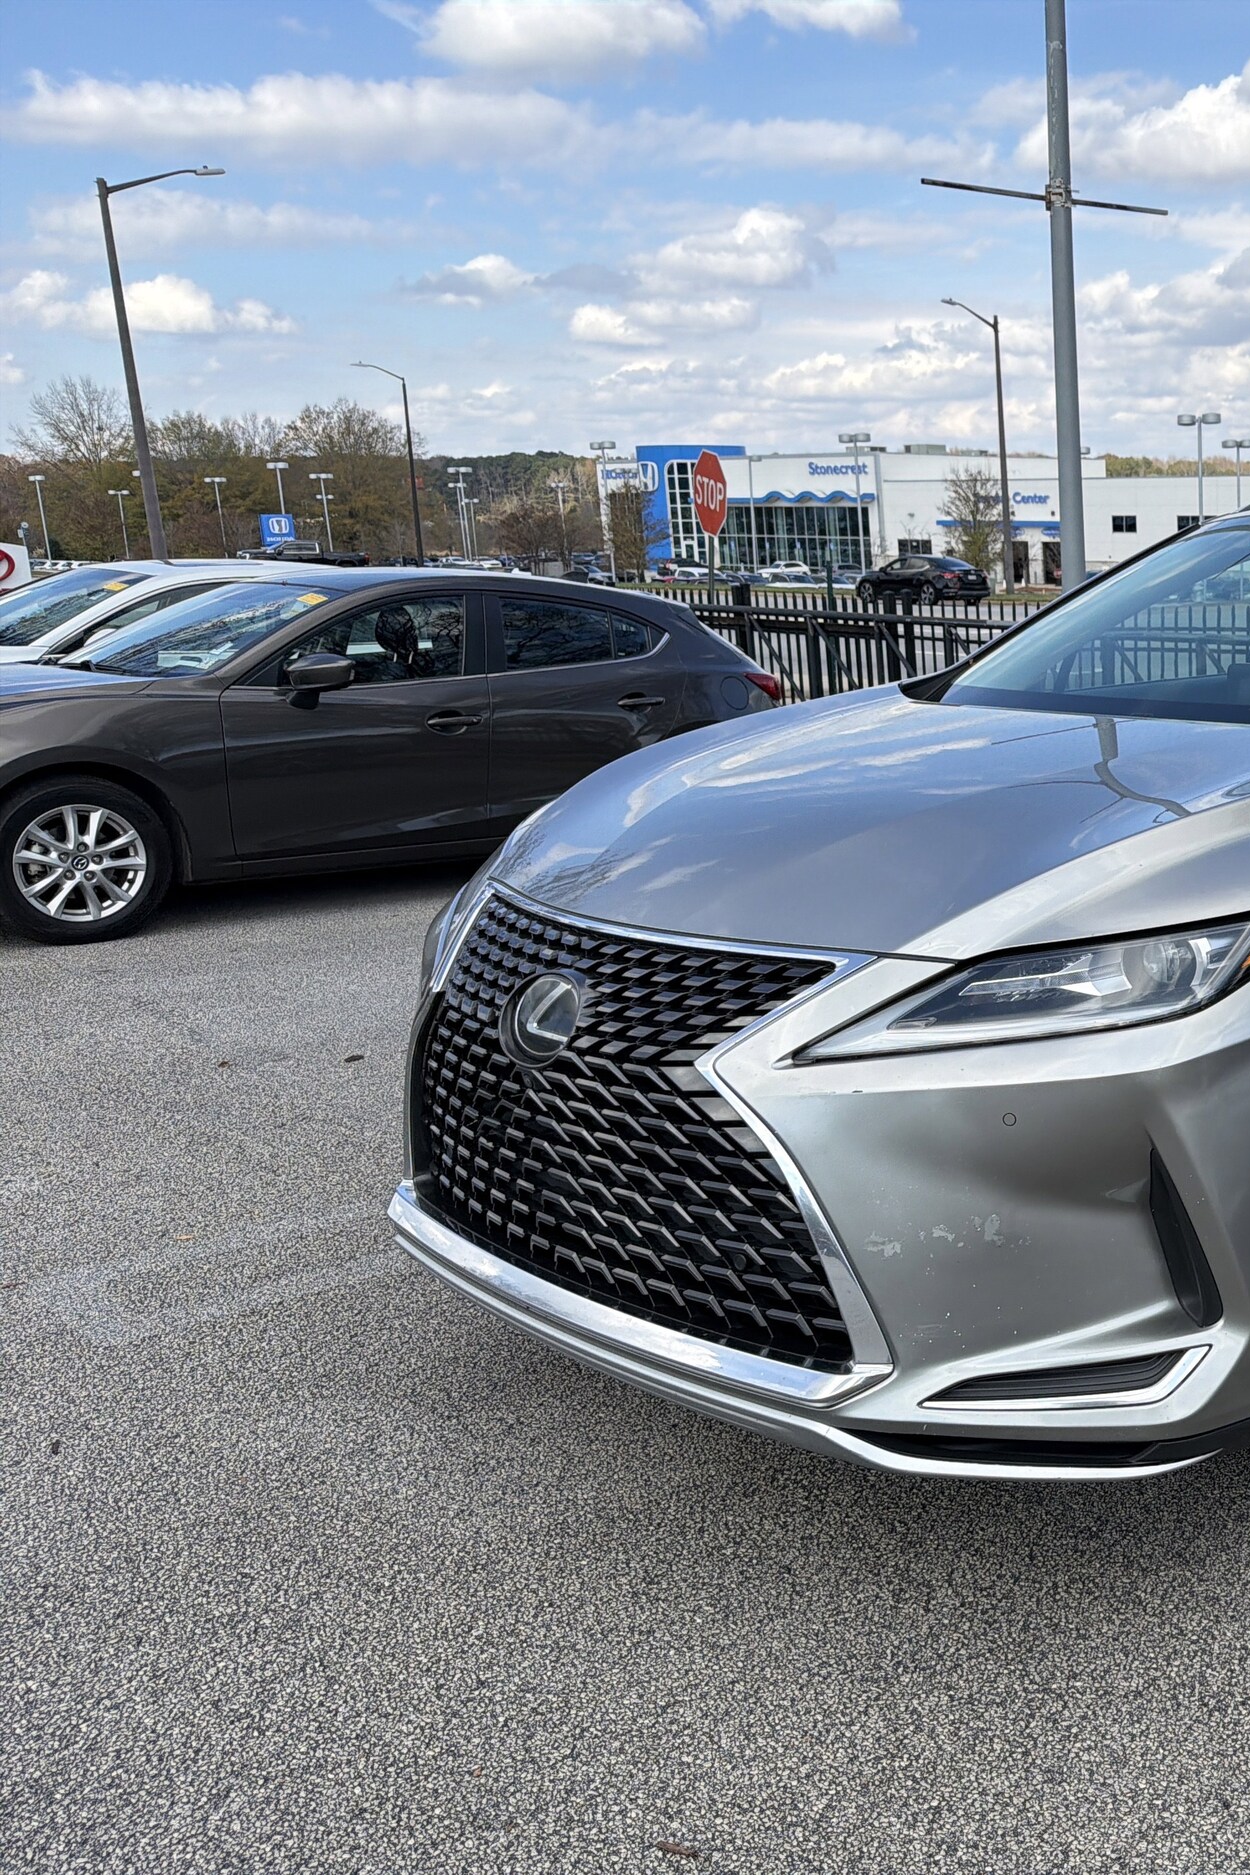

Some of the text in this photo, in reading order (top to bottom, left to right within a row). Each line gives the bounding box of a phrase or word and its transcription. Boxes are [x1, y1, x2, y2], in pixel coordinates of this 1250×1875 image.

[808, 461, 868, 476] Stonecrest
[695, 474, 724, 512] STOP
[1012, 491, 1050, 505] Center
